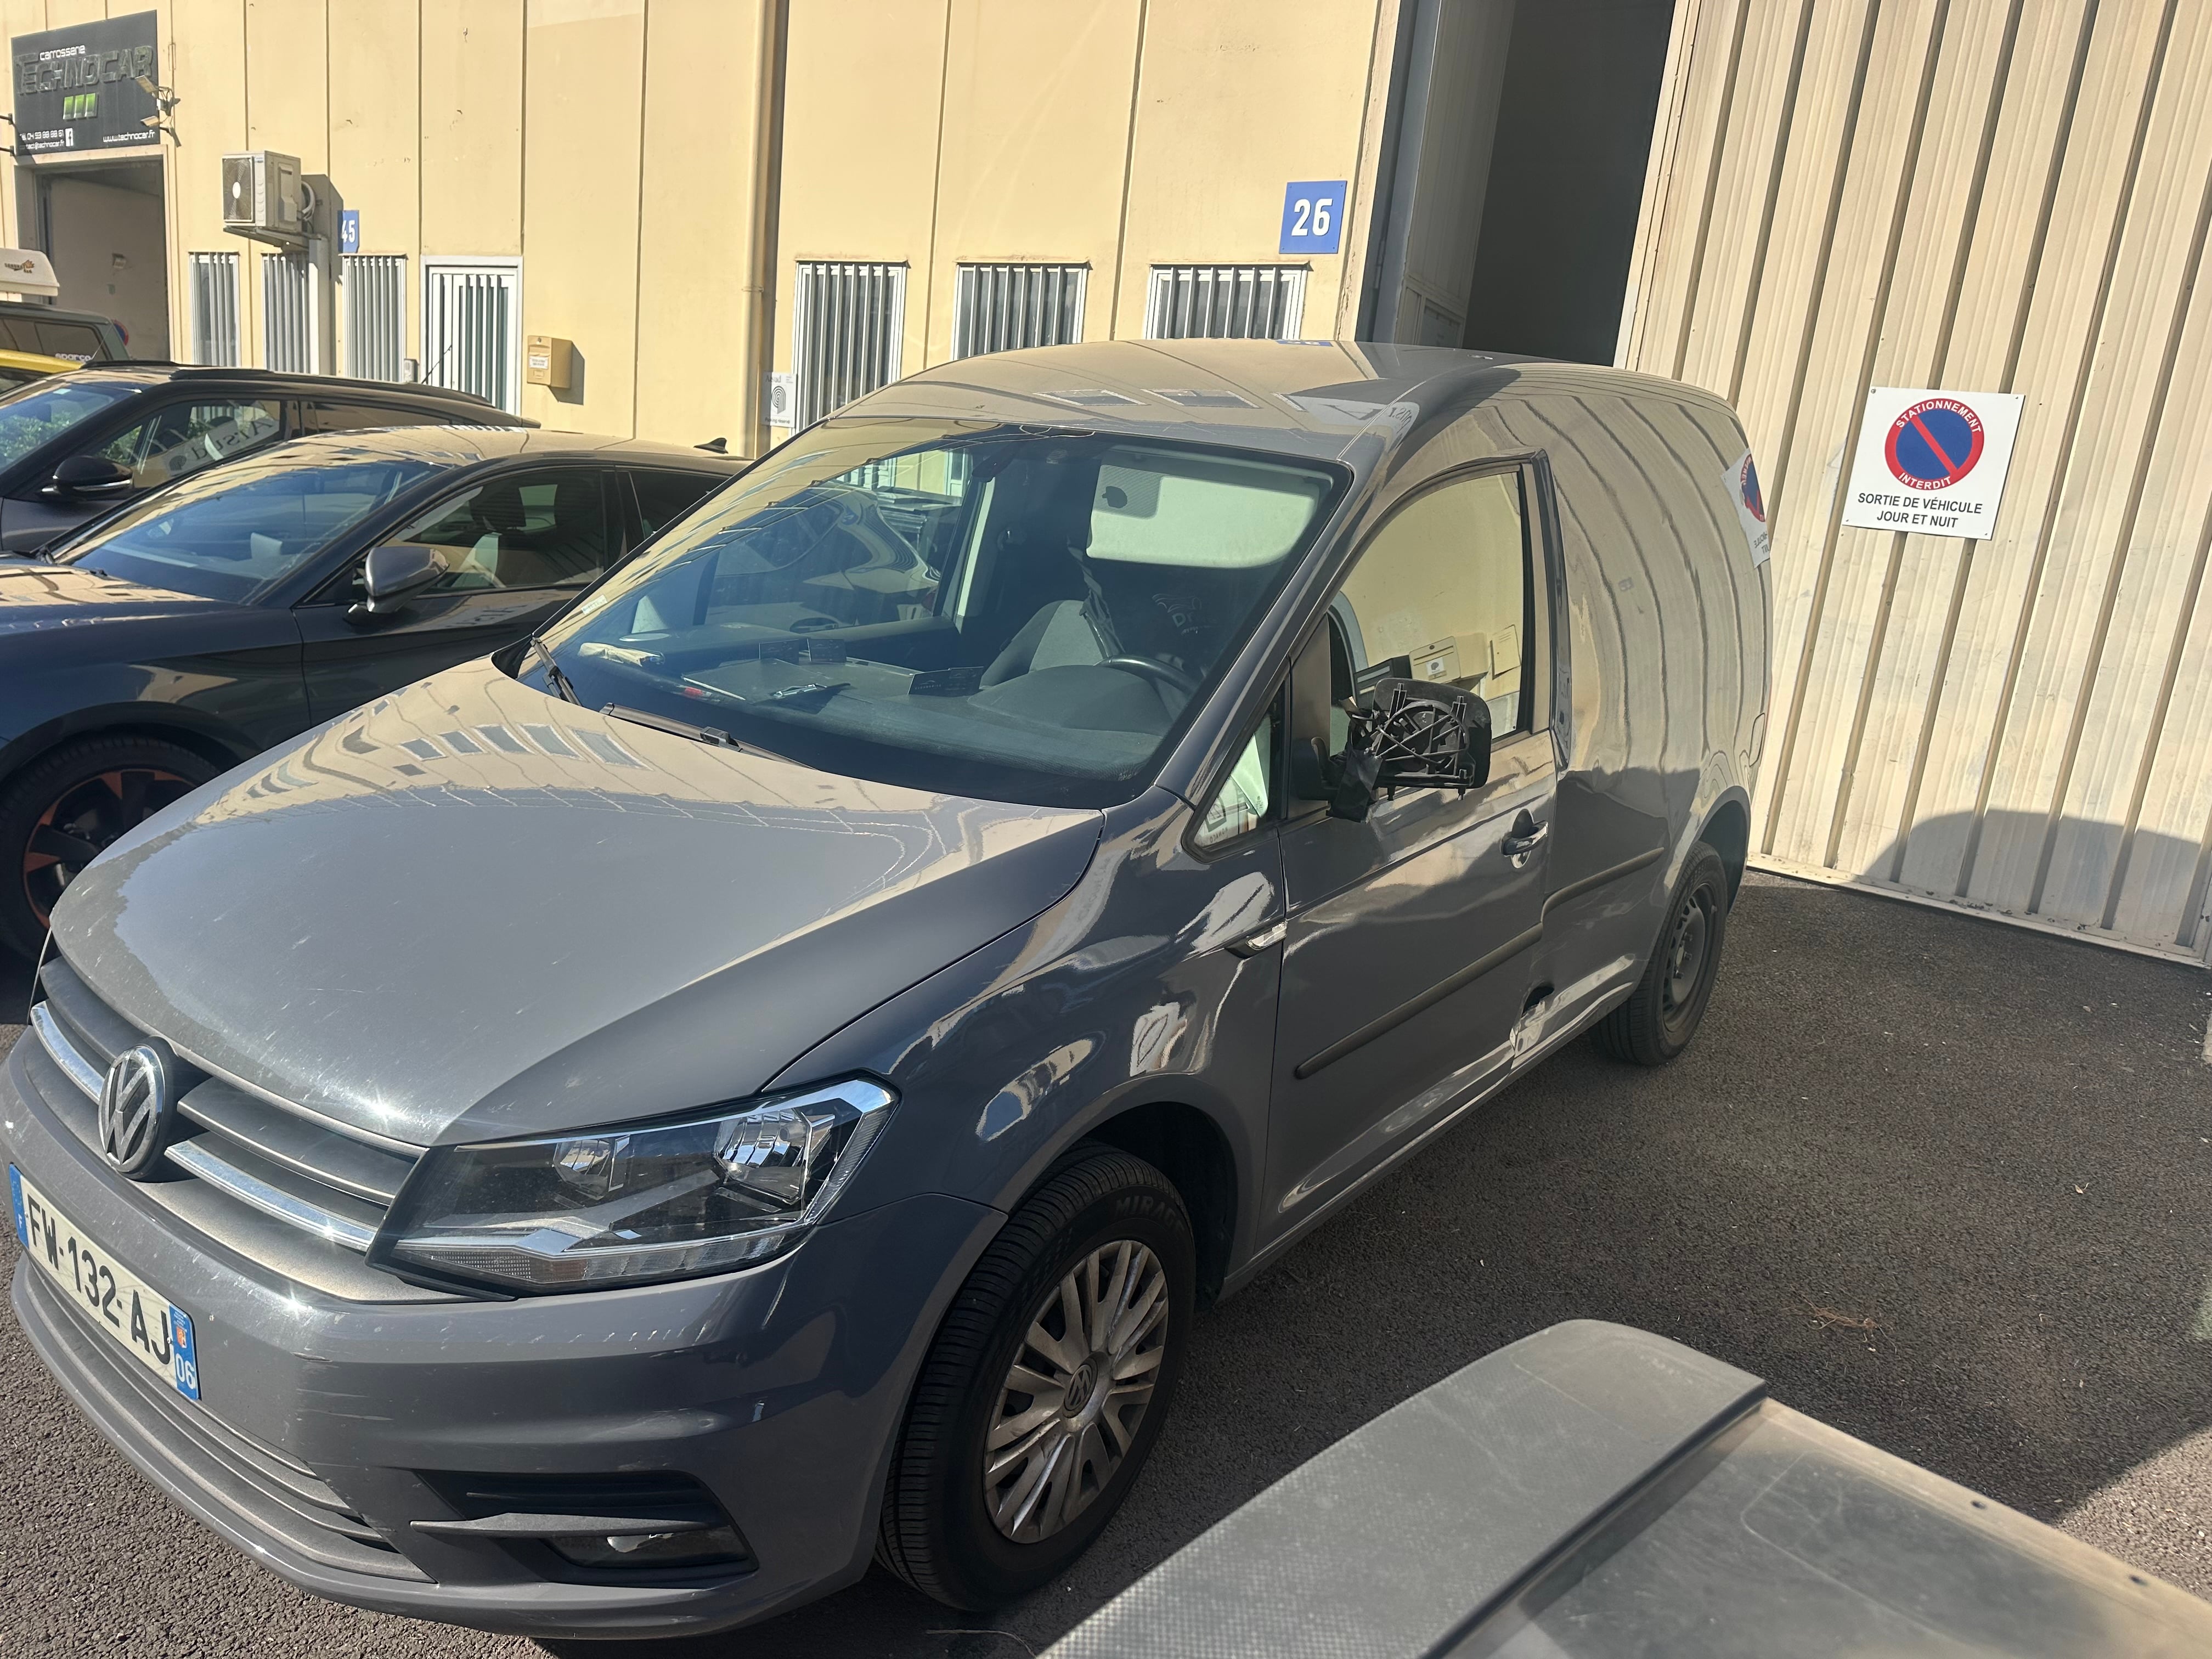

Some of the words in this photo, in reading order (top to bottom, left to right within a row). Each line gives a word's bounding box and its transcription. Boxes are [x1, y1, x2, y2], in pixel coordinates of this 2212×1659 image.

[1291, 198, 1333, 236] 26
[341, 220, 356, 242] 45
[55, 353, 91, 362] sparco
[1896, 400, 1982, 432] STATIONNEMENT
[1898, 472, 1950, 490] INTERDIT
[1858, 493, 1900, 506] SORTIE
[1903, 496, 1919, 508] DE
[1923, 496, 1983, 514] VÉHICULE
[1877, 511, 1909, 523] JOUR
[1912, 514, 1927, 524] ET
[1930, 516, 1959, 528] NUIT
[18, 1214, 23, 1229] F
[28, 1194, 171, 1365] FW-132-AJ
[176, 1353, 196, 1390] 06
